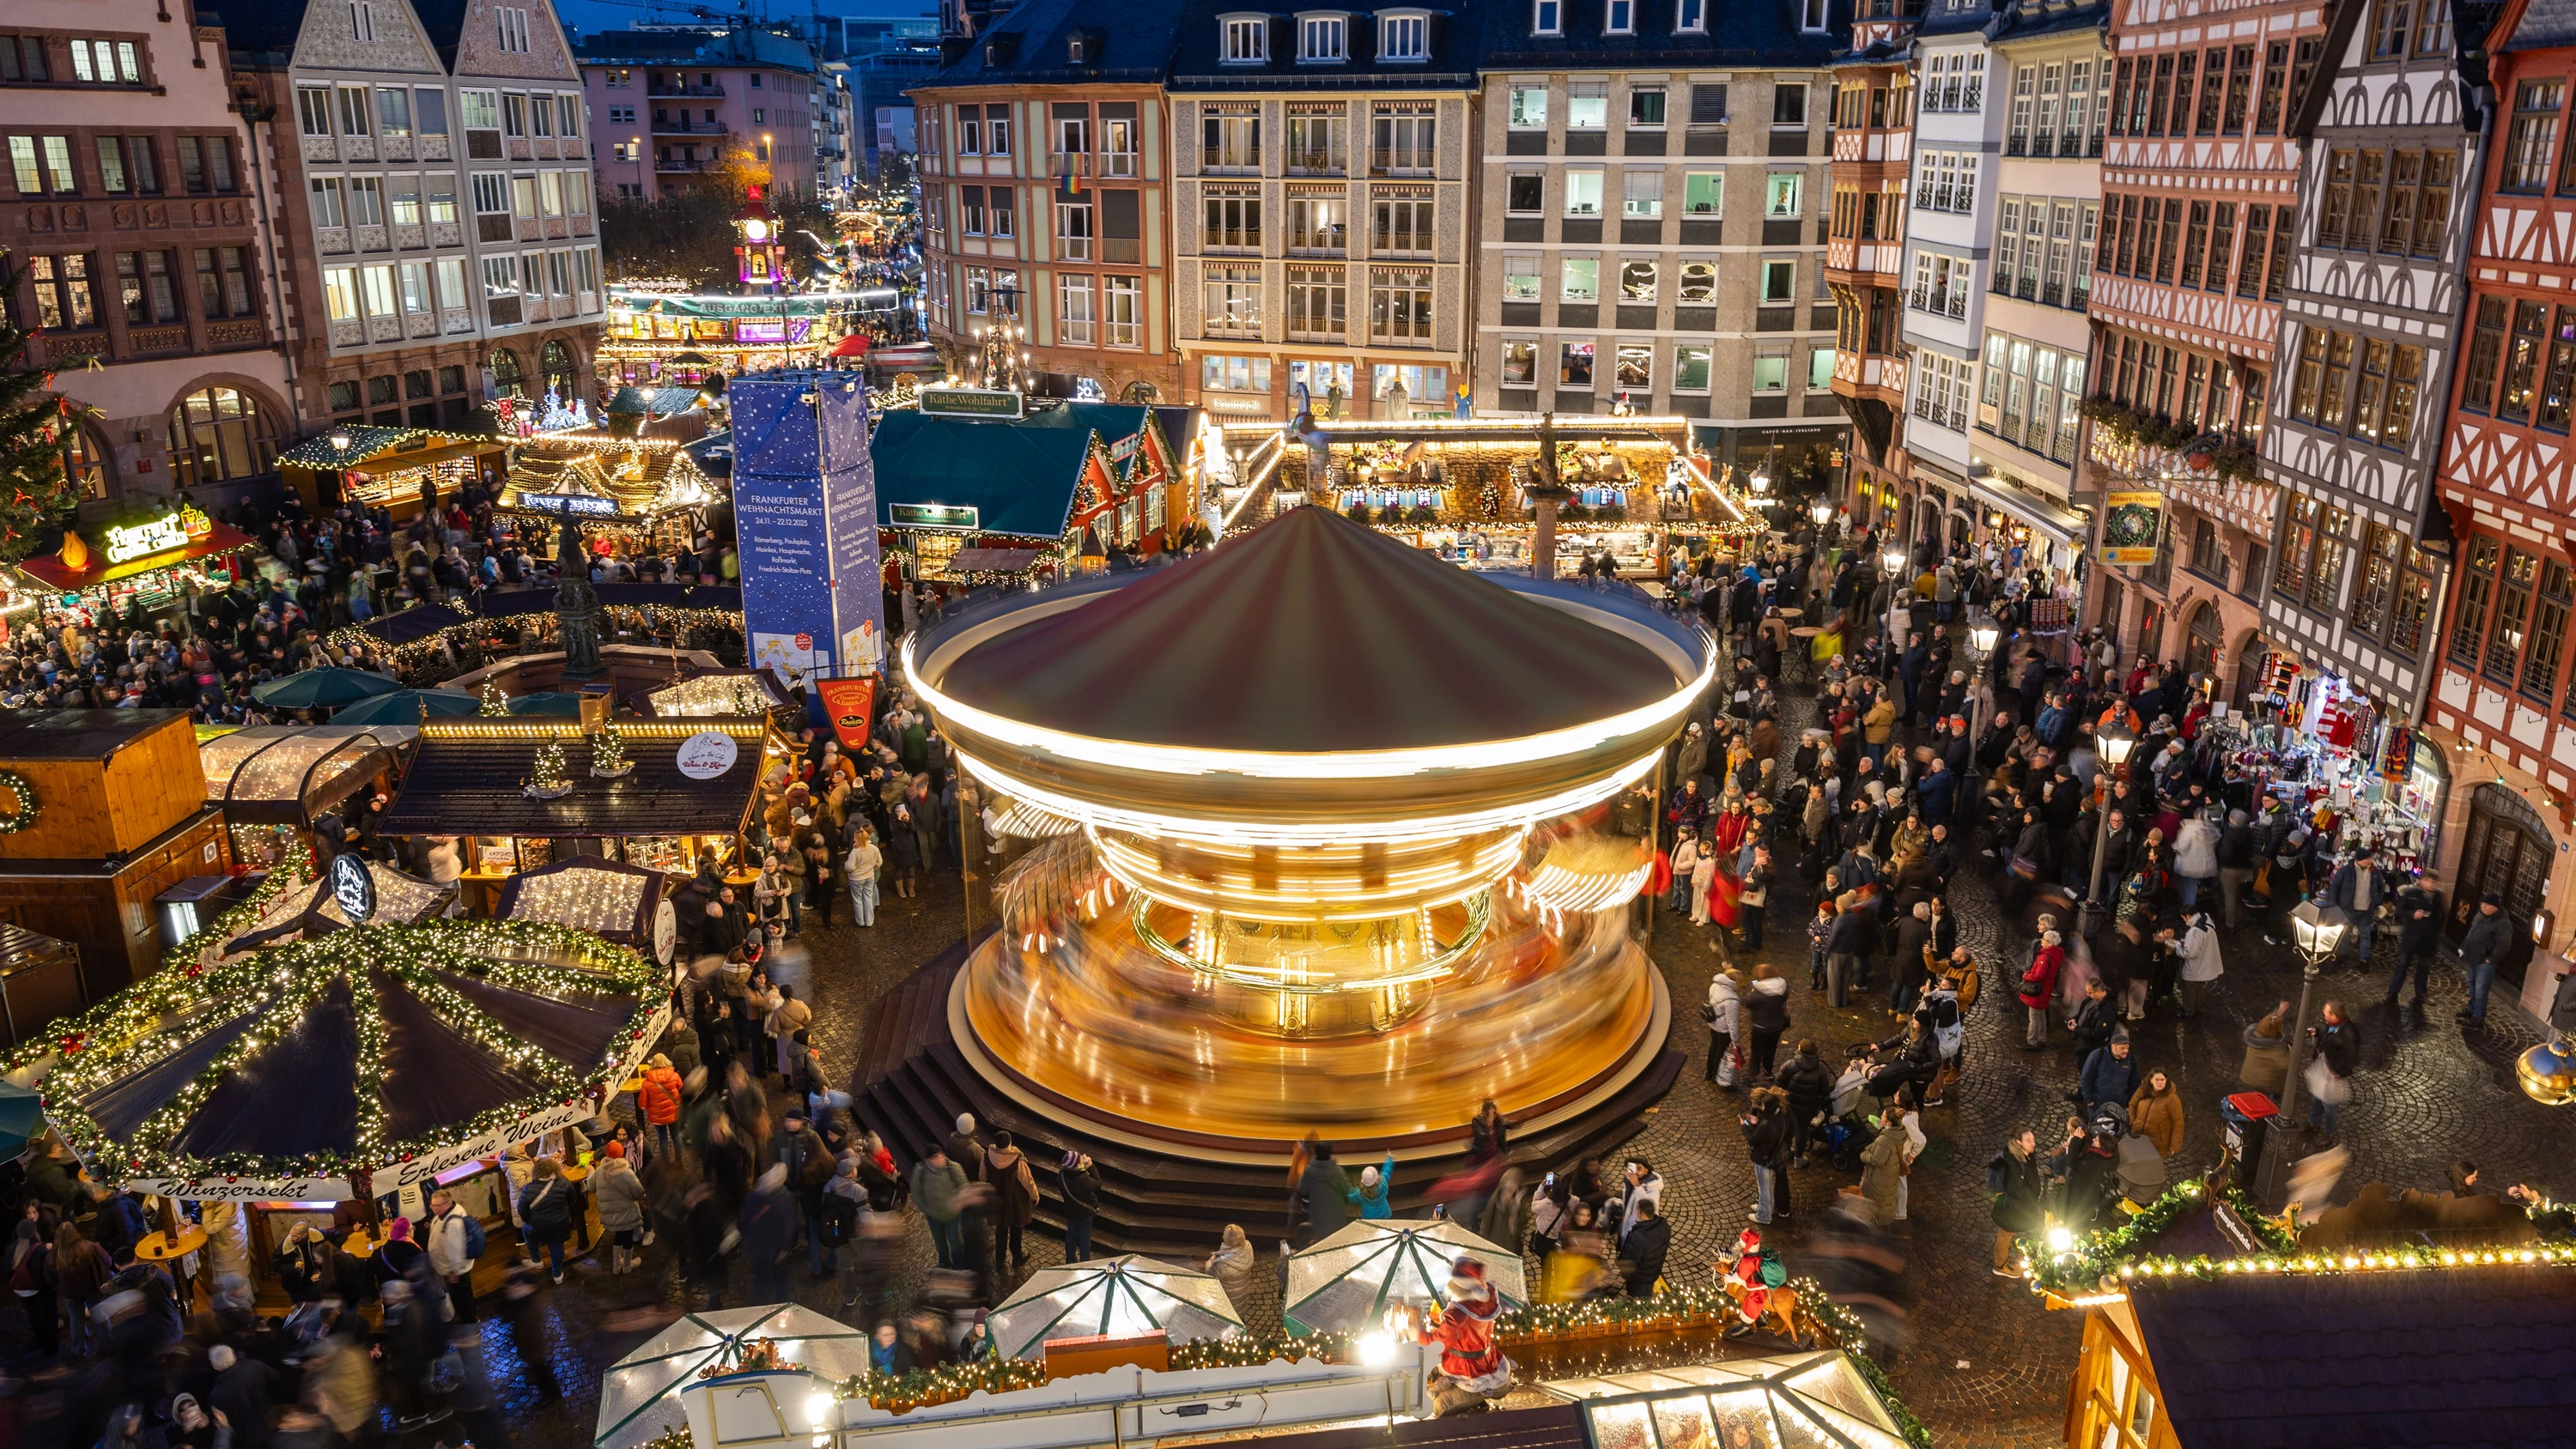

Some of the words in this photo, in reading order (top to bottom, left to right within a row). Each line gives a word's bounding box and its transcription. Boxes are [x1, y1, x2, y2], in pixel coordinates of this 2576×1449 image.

[930, 394, 957, 404] Käthe
[836, 485, 866, 502] FRANKFURTER
[751, 495, 809, 505] FRANKFURTER
[830, 492, 874, 514] WEIHNACHTSMARKT
[738, 504, 822, 516] WEIHNACHTSMARKT
[899, 507, 923, 516] Käthe
[777, 518, 808, 527] 22.12.2025
[754, 536, 784, 545] Römerberg,
[784, 538, 812, 546] Paulsplatz,
[779, 547, 812, 556] Hauptwache,
[771, 556, 797, 565] Roßmarkt,
[758, 565, 812, 575] Friedrich-Stoltze-Platz
[827, 685, 871, 696] FRANKFURTER
[398, 1139, 497, 1187] Erlesene
[503, 1110, 574, 1143] Weine
[157, 1180, 309, 1200] Winzersekt
[2216, 1204, 2251, 1251] Dampfnudeln
